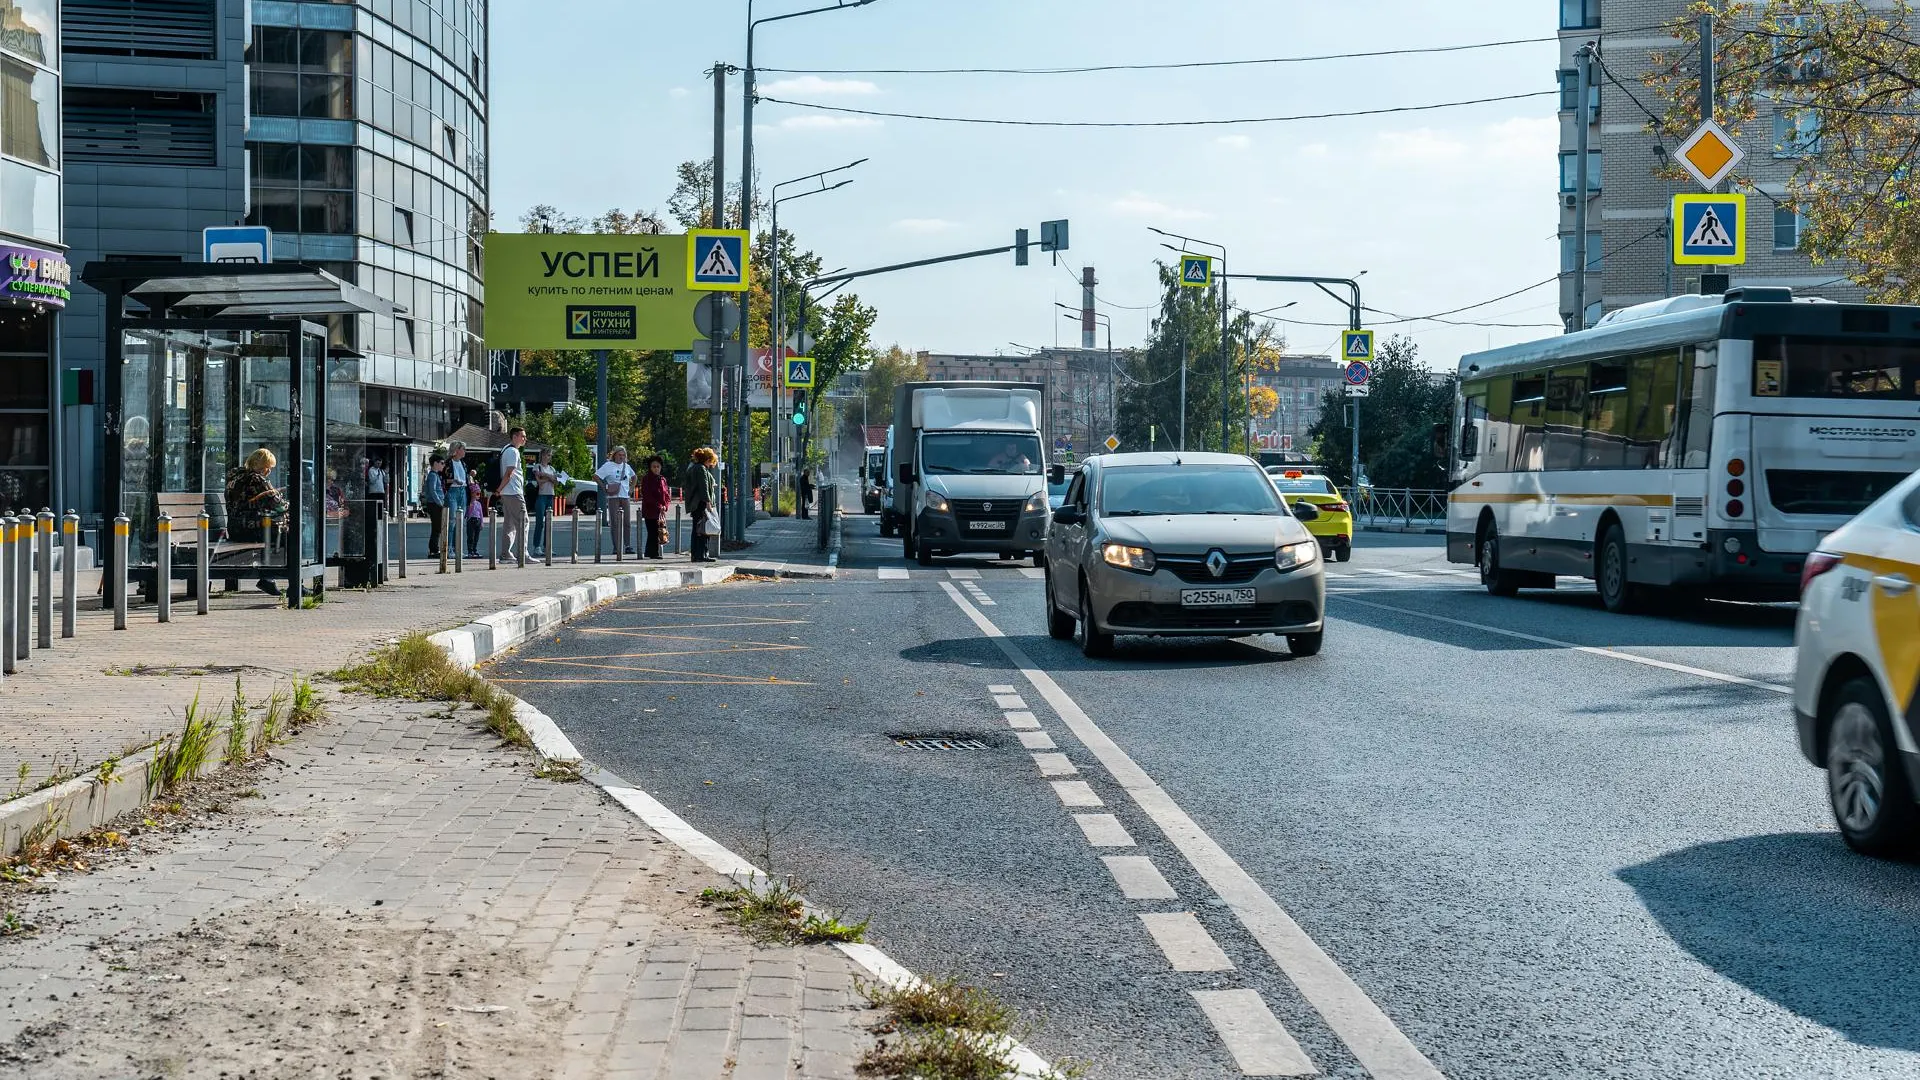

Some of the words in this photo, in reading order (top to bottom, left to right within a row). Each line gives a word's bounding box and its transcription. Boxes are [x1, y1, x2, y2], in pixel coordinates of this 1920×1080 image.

[541, 247, 659, 277] УСПЕЙ
[528, 286, 568, 296] купить
[571, 286, 586, 295] по
[589, 286, 633, 296] летним
[636, 287, 674, 296] ценам
[592, 310, 630, 318] СТИЛЬНЫЕ
[592, 318, 631, 328] КУХНИ
[799, 402, 805, 413] 4
[1809, 427, 1916, 437] МОСТРАНСАВТО
[1234, 589, 1252, 599] 750
